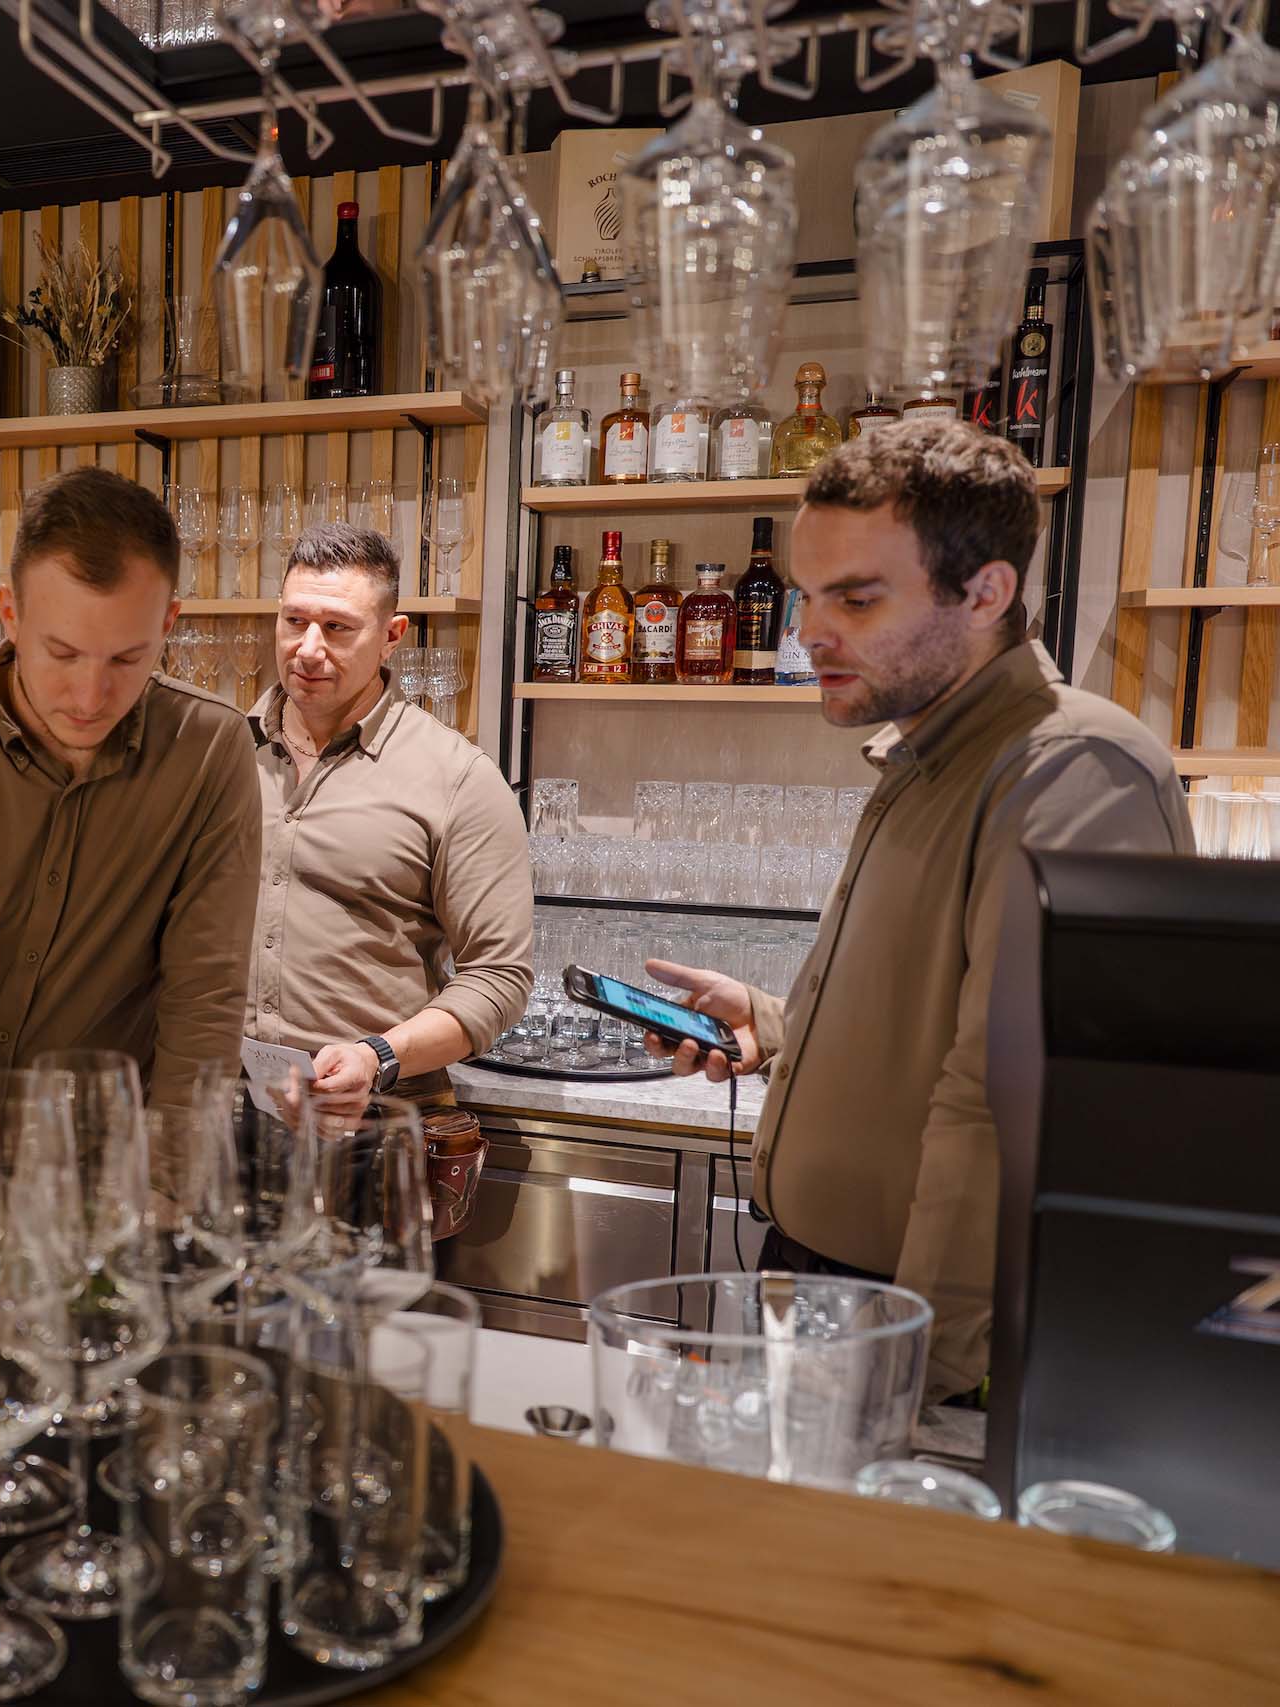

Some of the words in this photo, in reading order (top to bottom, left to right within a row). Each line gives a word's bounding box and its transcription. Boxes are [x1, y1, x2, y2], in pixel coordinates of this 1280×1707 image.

[587, 173, 617, 188] ROCH
[592, 622, 624, 631] CHIVAS
[613, 664, 622, 673] 12
